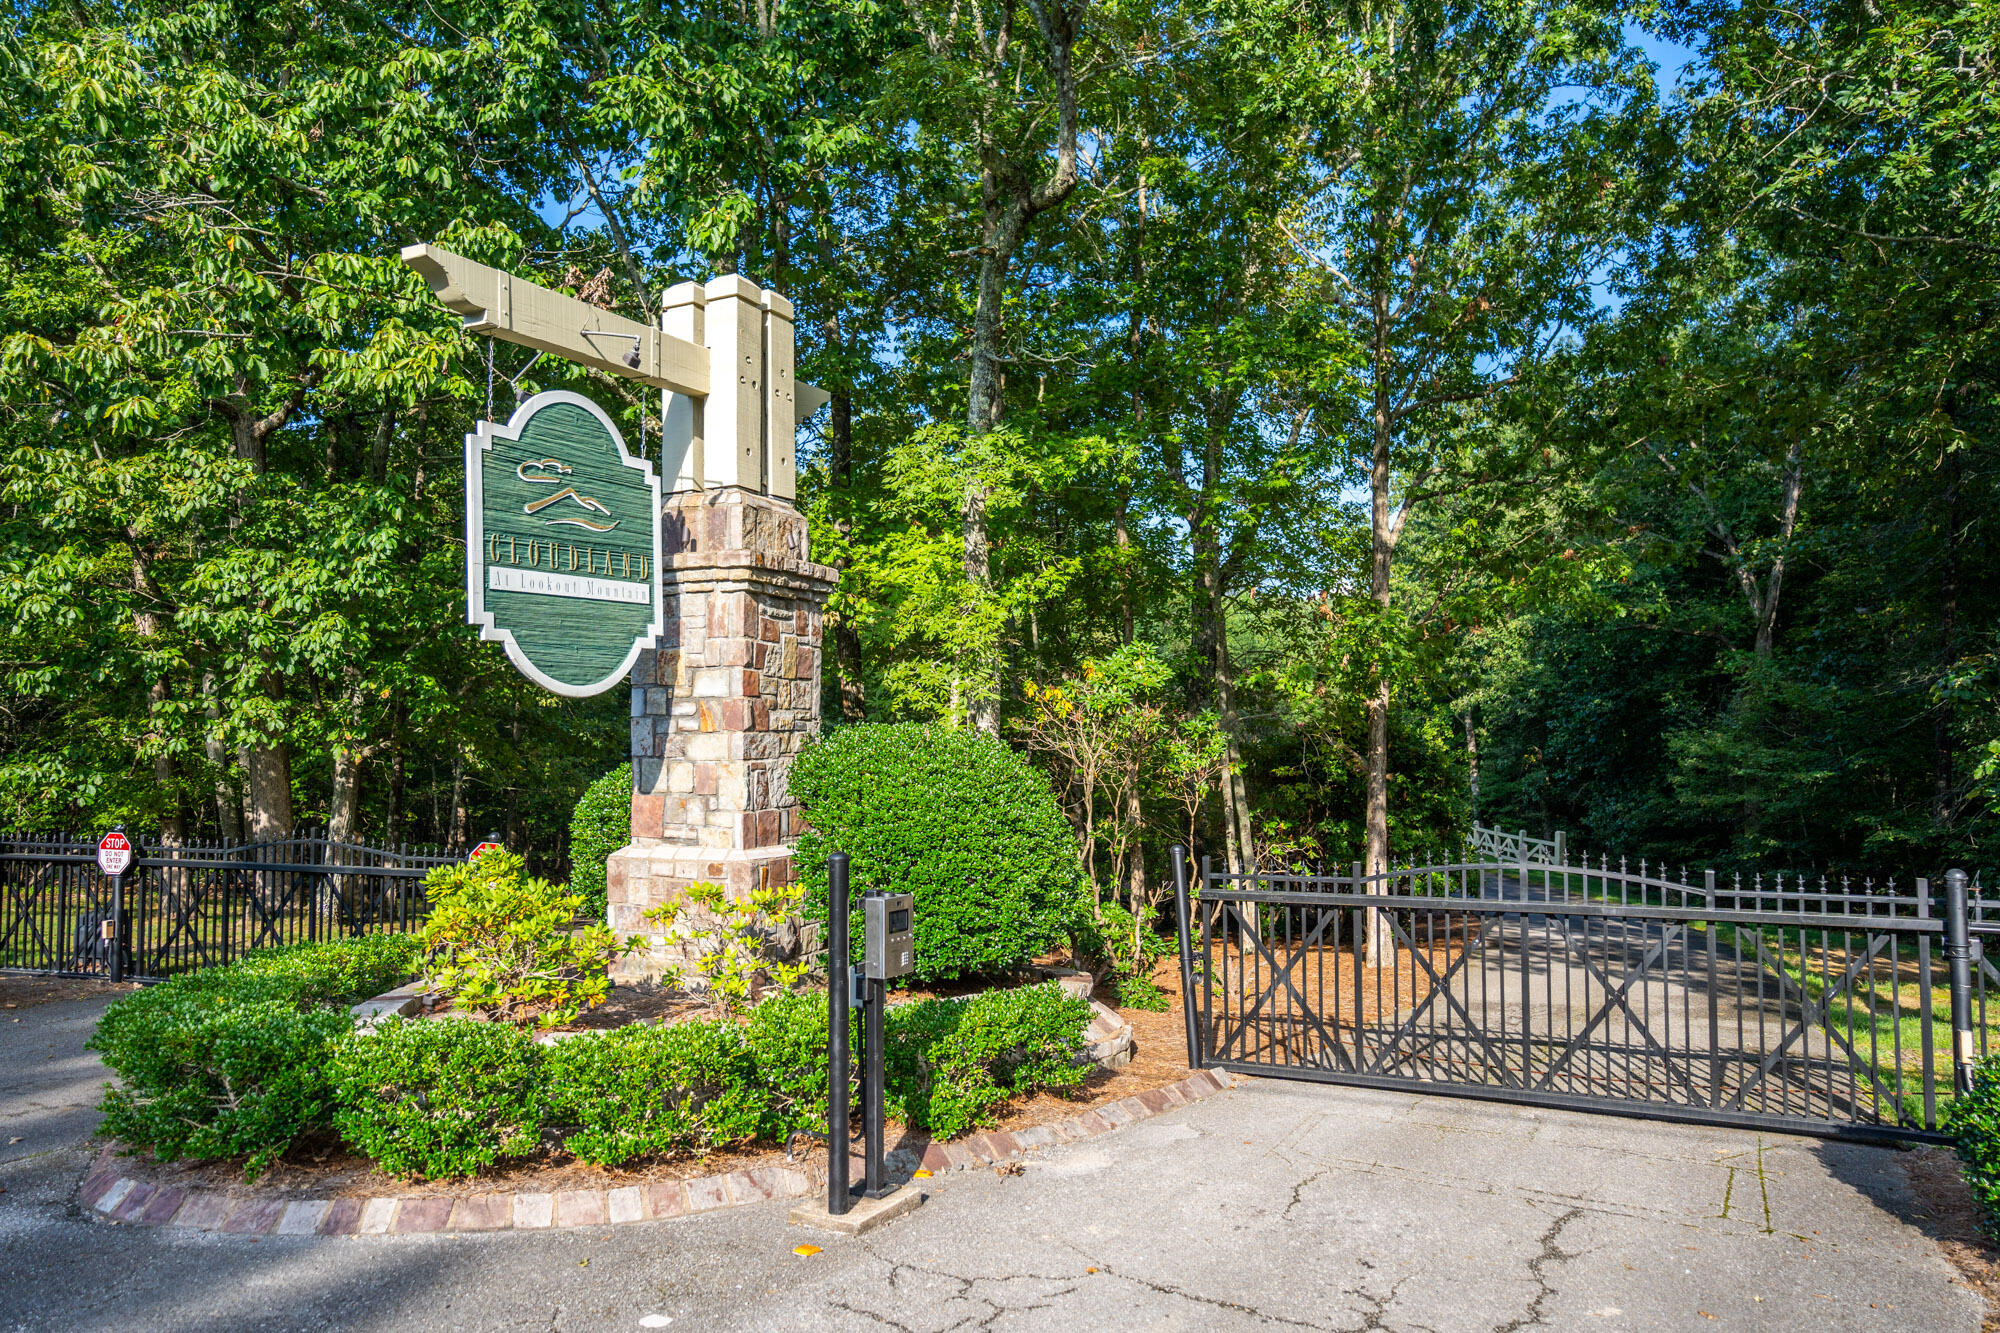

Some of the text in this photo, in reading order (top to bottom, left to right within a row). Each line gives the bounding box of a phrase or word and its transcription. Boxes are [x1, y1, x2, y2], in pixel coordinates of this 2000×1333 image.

[490, 533, 649, 580] CLOUDLAND
[494, 570, 647, 601] At Lookout Mountain
[106, 838, 125, 848] STOP
